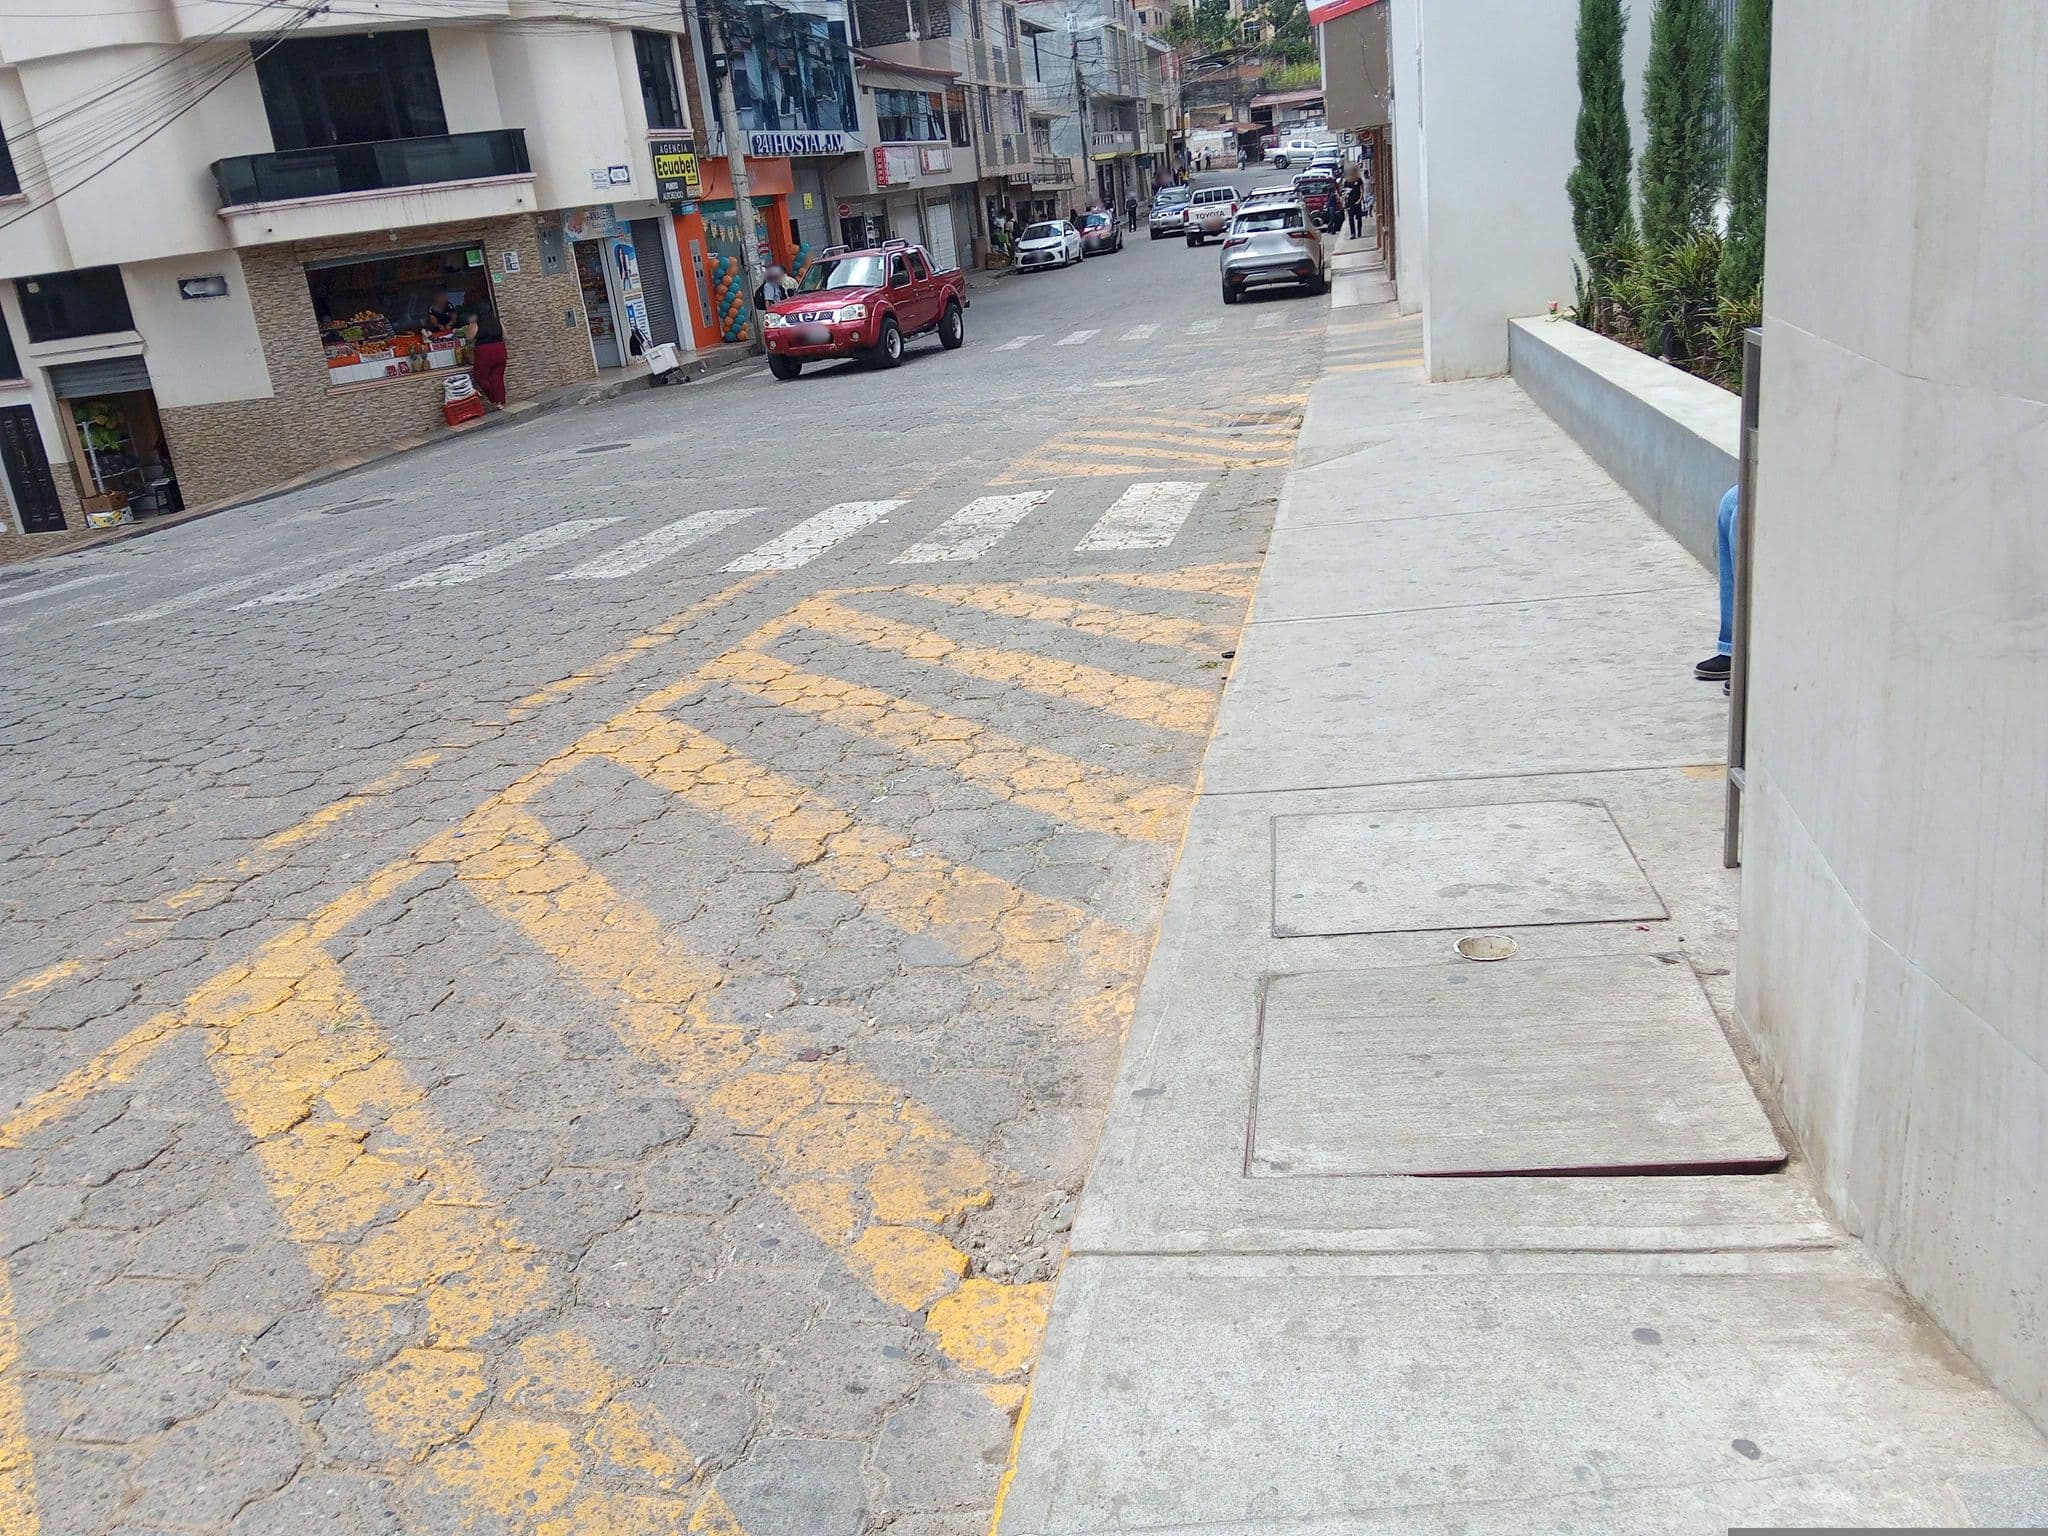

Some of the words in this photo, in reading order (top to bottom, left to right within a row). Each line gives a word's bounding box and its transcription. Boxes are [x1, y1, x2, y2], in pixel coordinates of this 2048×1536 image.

[659, 144, 688, 153] AGENCIA
[775, 134, 825, 153] HOSTAL
[656, 157, 695, 176] Ecuabet
[1195, 211, 1225, 220] TOYOTA
